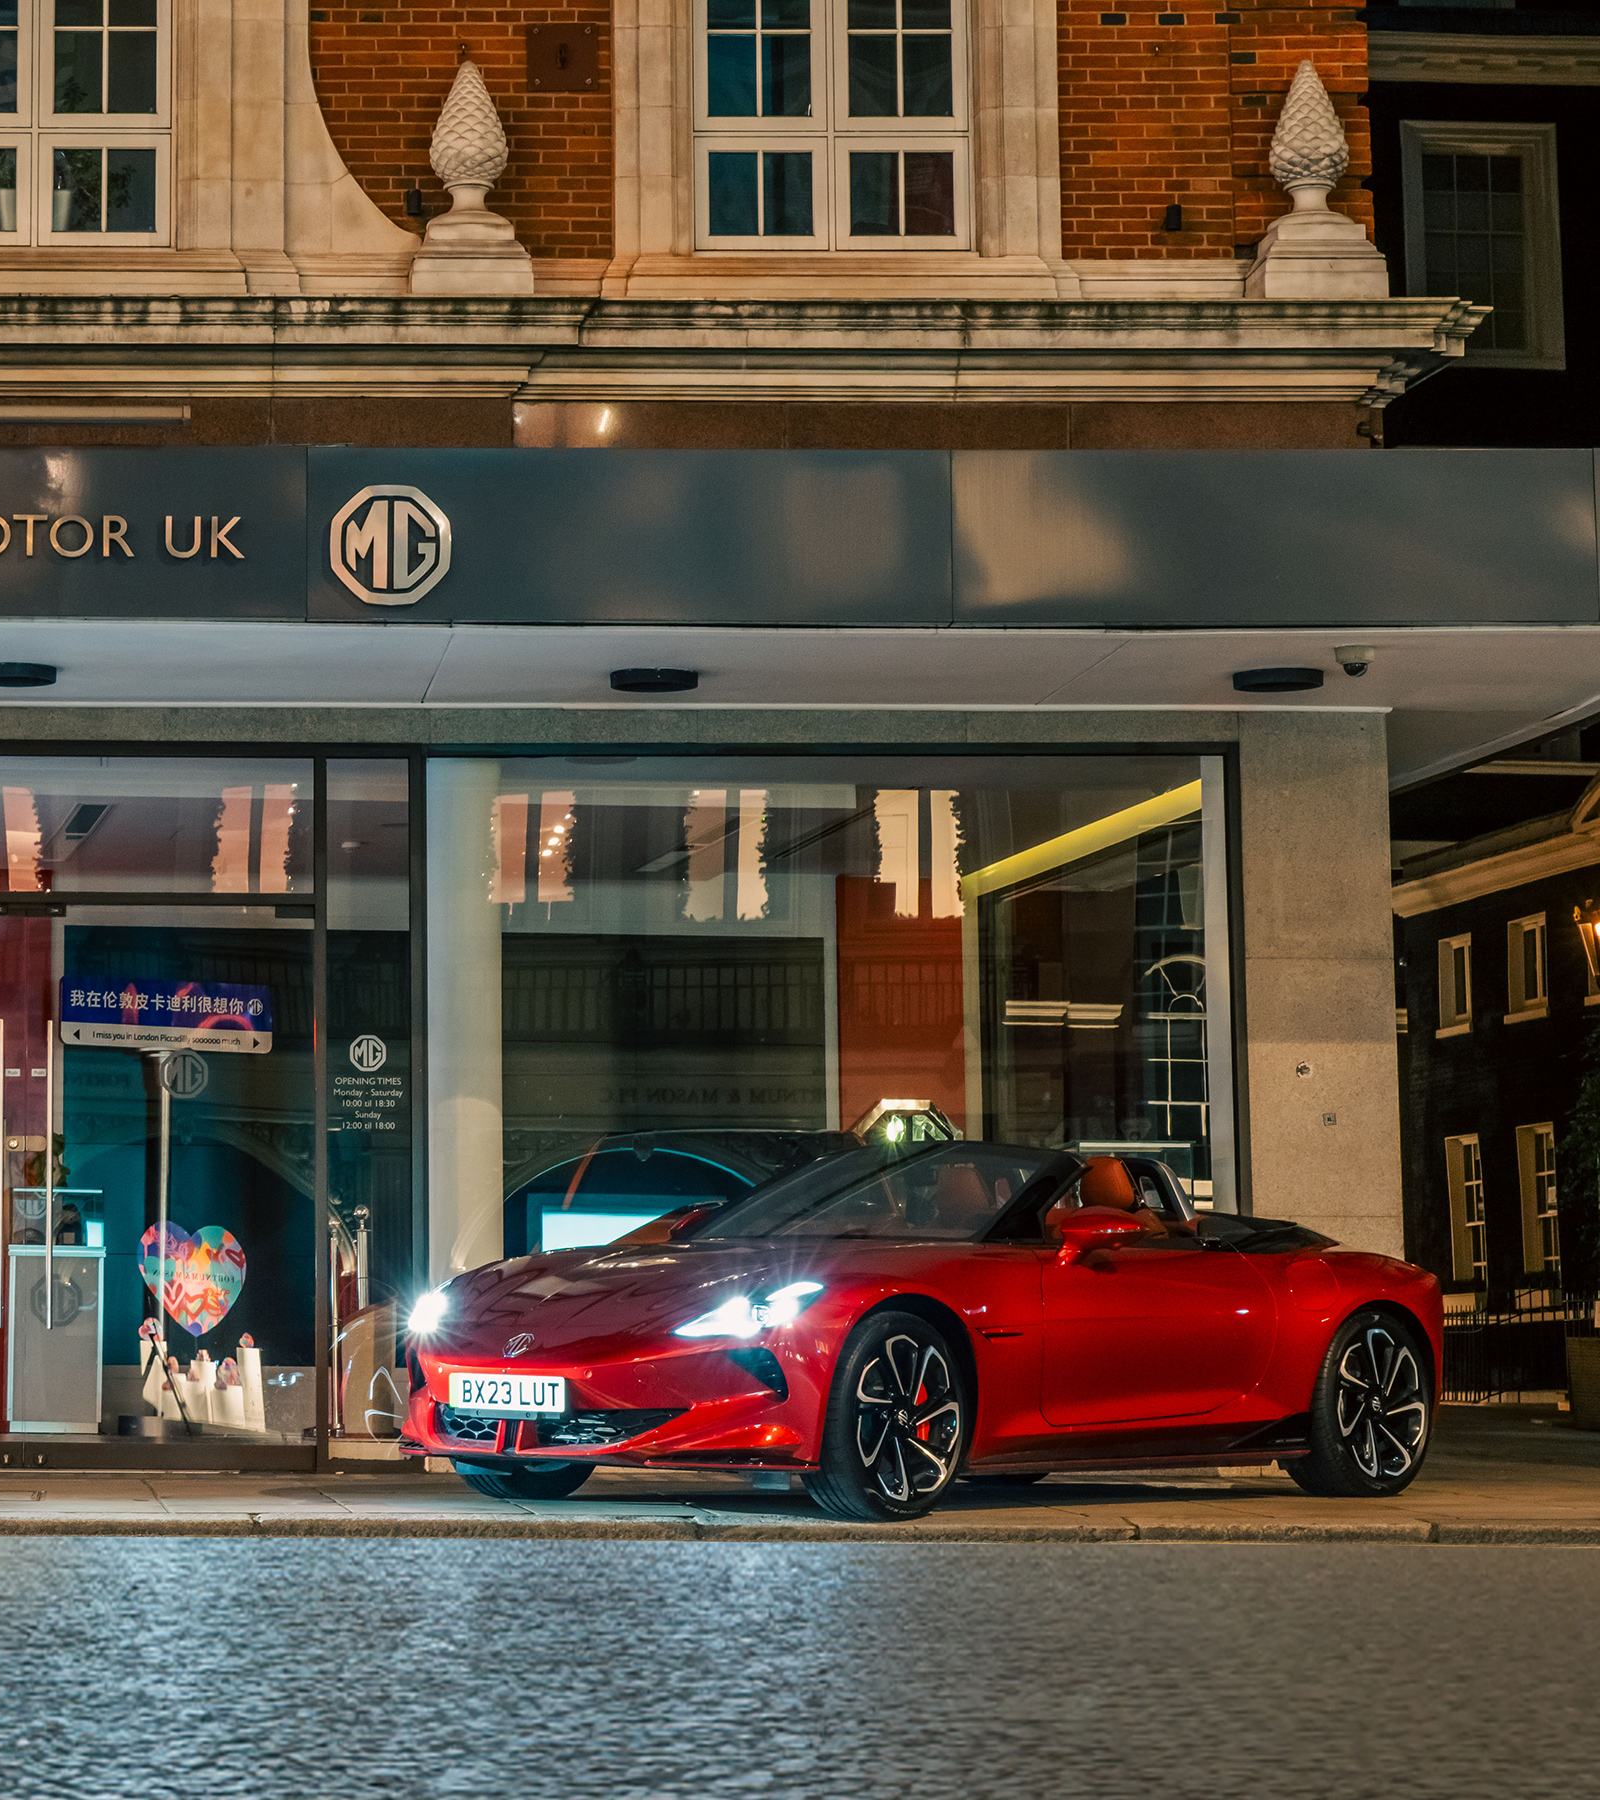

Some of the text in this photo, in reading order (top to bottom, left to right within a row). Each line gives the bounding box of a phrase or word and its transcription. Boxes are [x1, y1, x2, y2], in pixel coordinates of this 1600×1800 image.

[165, 515, 245, 558] UK
[344, 499, 438, 590] MG
[70, 989, 244, 1015] 我在伦敦皮卡迪利很想你
[92, 1030, 95, 1038] I
[96, 1031, 112, 1039] miss
[112, 1033, 126, 1042] you
[126, 1032, 133, 1040] in
[133, 1032, 160, 1041] London
[221, 1037, 241, 1045] much
[353, 1039, 382, 1067] MG
[165, 1055, 204, 1093] MG
[334, 1077, 402, 1086] OPENING TIMES
[333, 1088, 363, 1098] Monday
[370, 1088, 404, 1098] Saturday
[342, 1099, 396, 1107] 10:00 til 18:30
[355, 1110, 382, 1120] Sunday
[342, 1121, 396, 1130] 12:00 til 18:00
[462, 1380, 559, 1407] BX23 LUT
